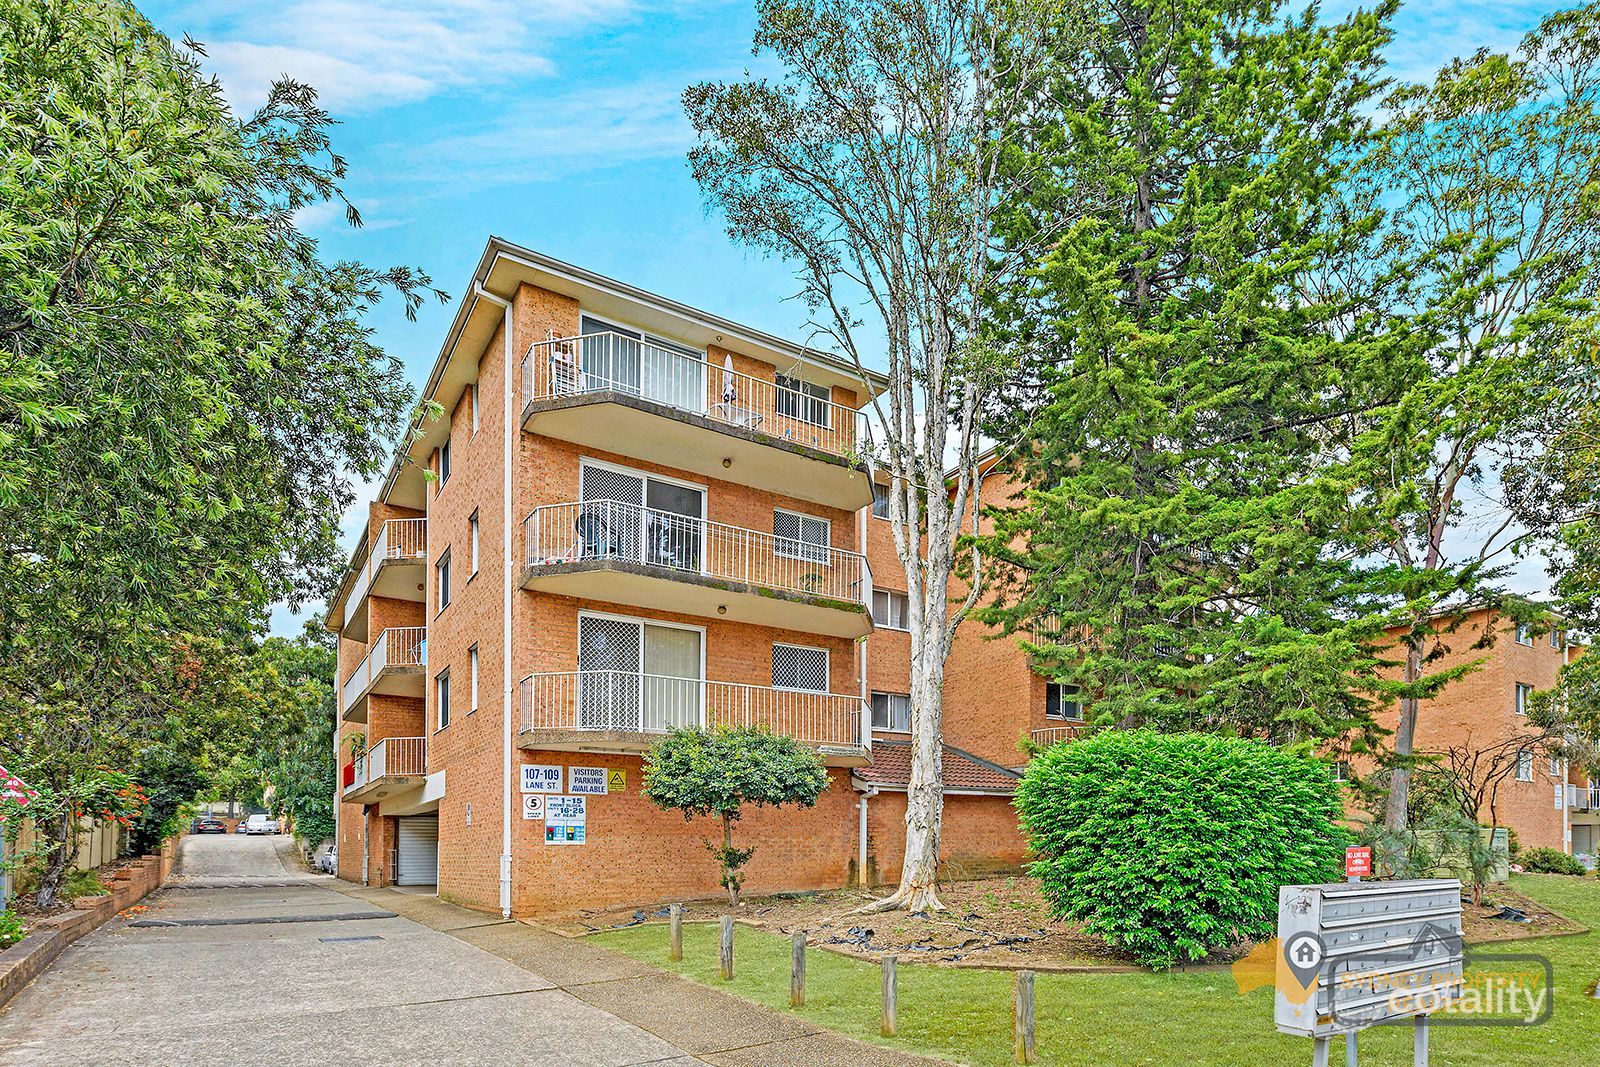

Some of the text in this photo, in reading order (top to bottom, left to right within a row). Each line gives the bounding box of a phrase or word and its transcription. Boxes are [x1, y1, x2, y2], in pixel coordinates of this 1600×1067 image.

[524, 768, 559, 781] 107-109
[573, 768, 604, 776] VISITORS
[574, 776, 603, 785] PARKING
[525, 781, 558, 790] LANE ST.
[571, 785, 605, 793] AVAILABLE
[530, 798, 537, 808] 5
